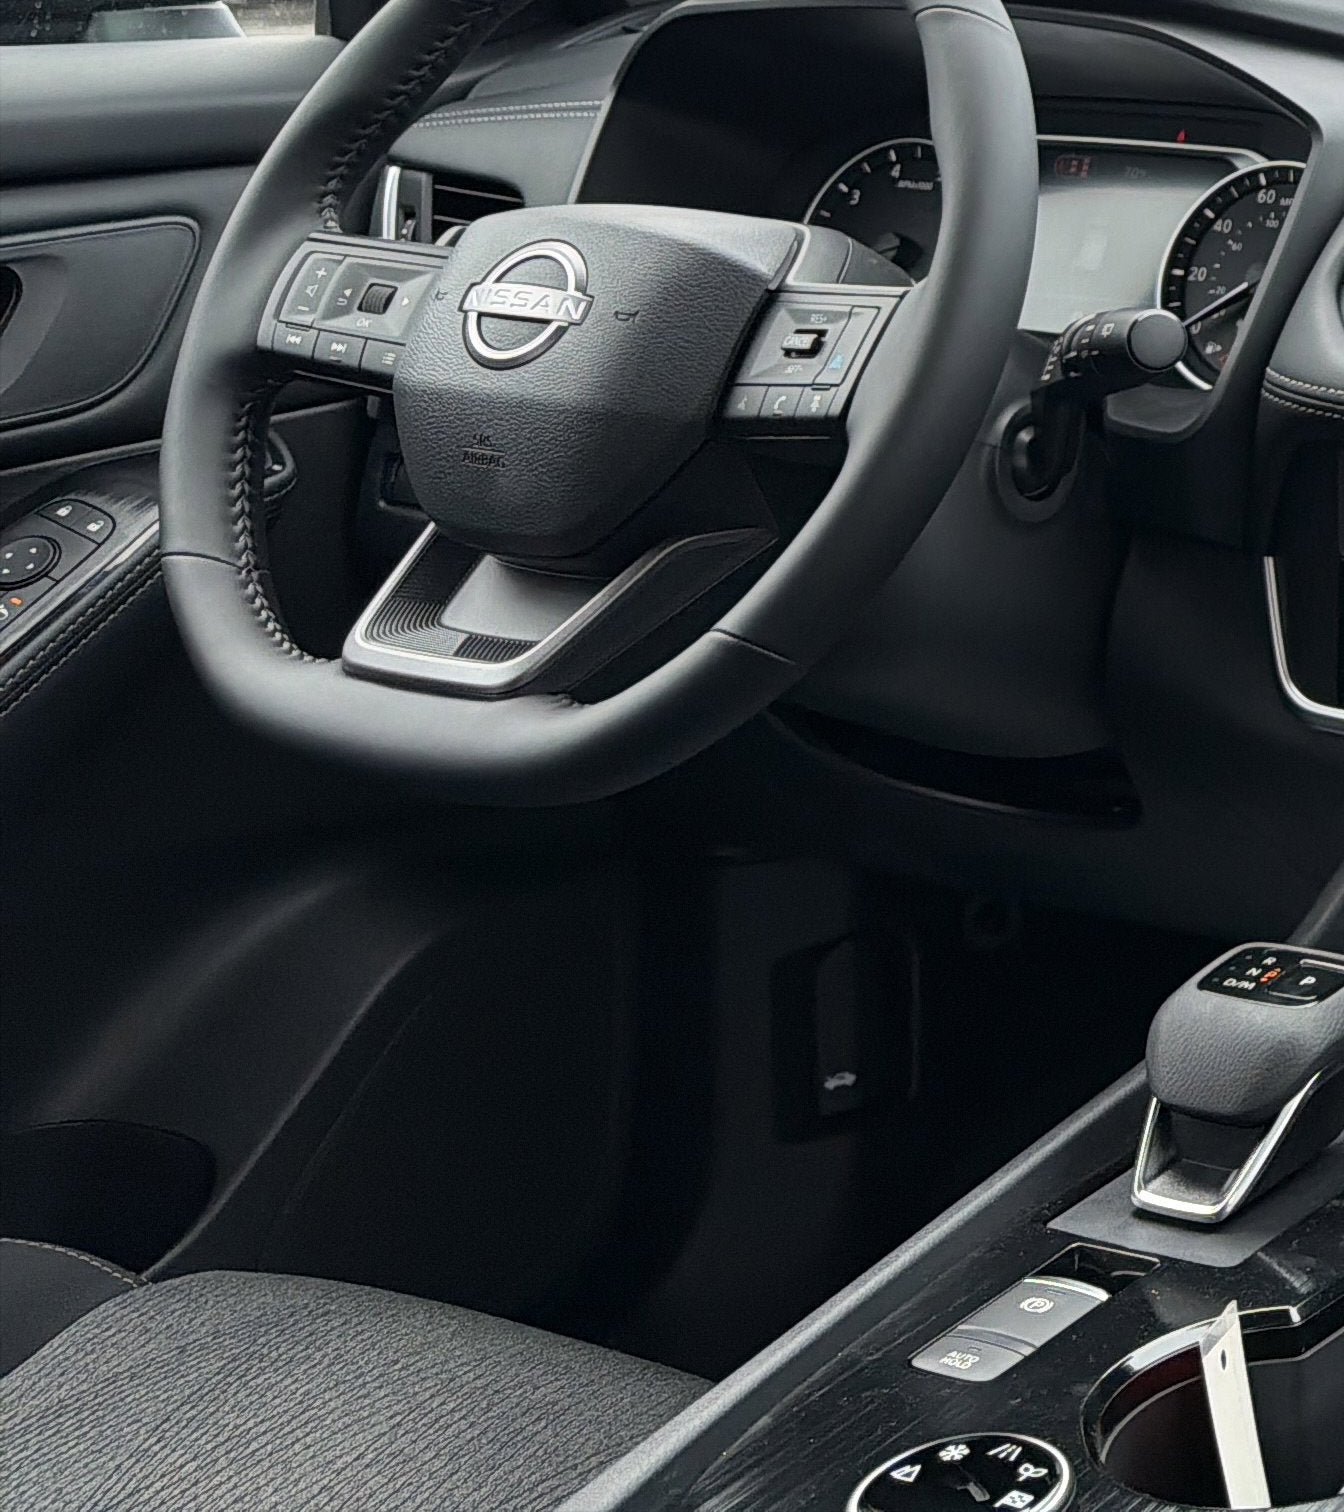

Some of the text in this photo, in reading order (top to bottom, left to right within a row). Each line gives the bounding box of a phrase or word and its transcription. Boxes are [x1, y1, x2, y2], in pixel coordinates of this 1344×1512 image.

[849, 189, 860, 205] 3
[1257, 188, 1276, 204] 60
[1213, 218, 1233, 234] 40
[1187, 266, 1207, 281] 20
[466, 287, 588, 320] NISSAN
[1262, 956, 1277, 966] R
[1245, 967, 1262, 976] N
[1222, 977, 1256, 990] D/M
[1298, 975, 1316, 985] P
[948, 1350, 980, 1363] AUTO
[939, 1357, 972, 1370] HOLD
